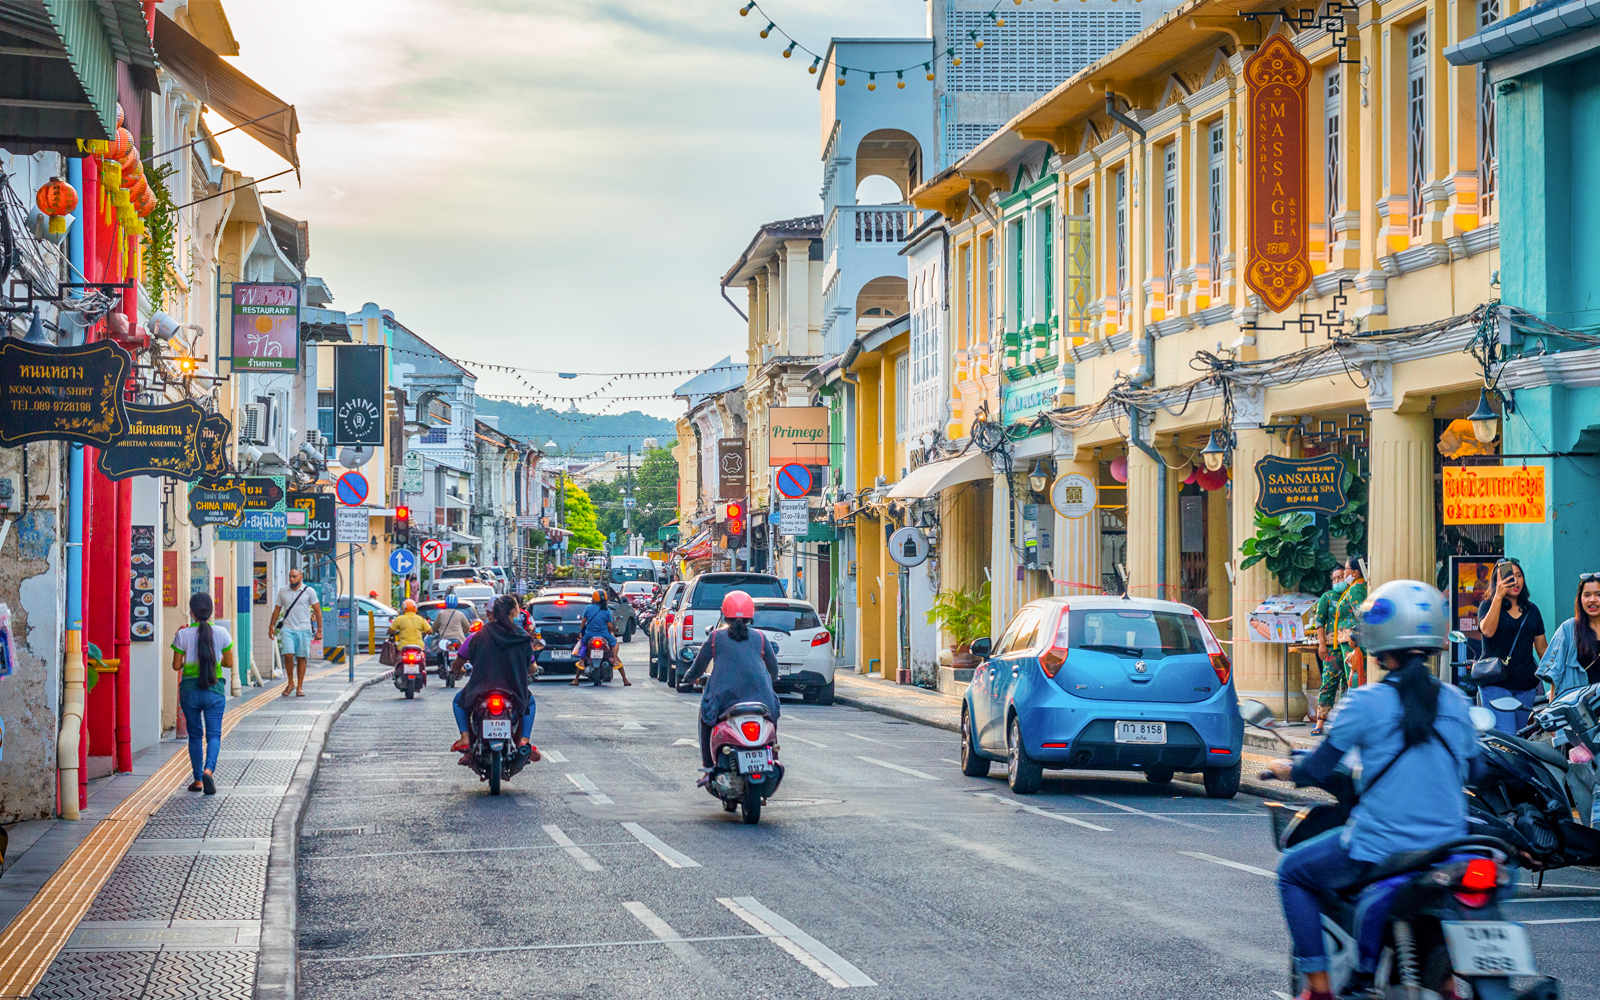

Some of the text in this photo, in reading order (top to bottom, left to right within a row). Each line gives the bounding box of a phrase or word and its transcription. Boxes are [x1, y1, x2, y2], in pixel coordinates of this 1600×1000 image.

[1259, 103, 1267, 183] SANSABAI
[1270, 102, 1285, 235] MASSAGE
[1267, 242, 1290, 255] 按摩
[242, 306, 290, 314] RESTAURANT
[247, 358, 282, 368] ร้านอาหาร
[19, 364, 84, 380] หนนหลาง
[9, 385, 55, 395] NONLANG
[339, 398, 379, 419] CHINO
[772, 425, 824, 441] Primego
[1269, 473, 1334, 485] SANSABAI
[1269, 486, 1310, 494] MASSAGE
[1320, 485, 1335, 493] SPA
[196, 501, 237, 511] CHINA INN
[220, 531, 286, 540] OLDEST HERBS SHOP
[1123, 723, 1162, 734] กว 8158
[747, 764, 765, 772] 897
